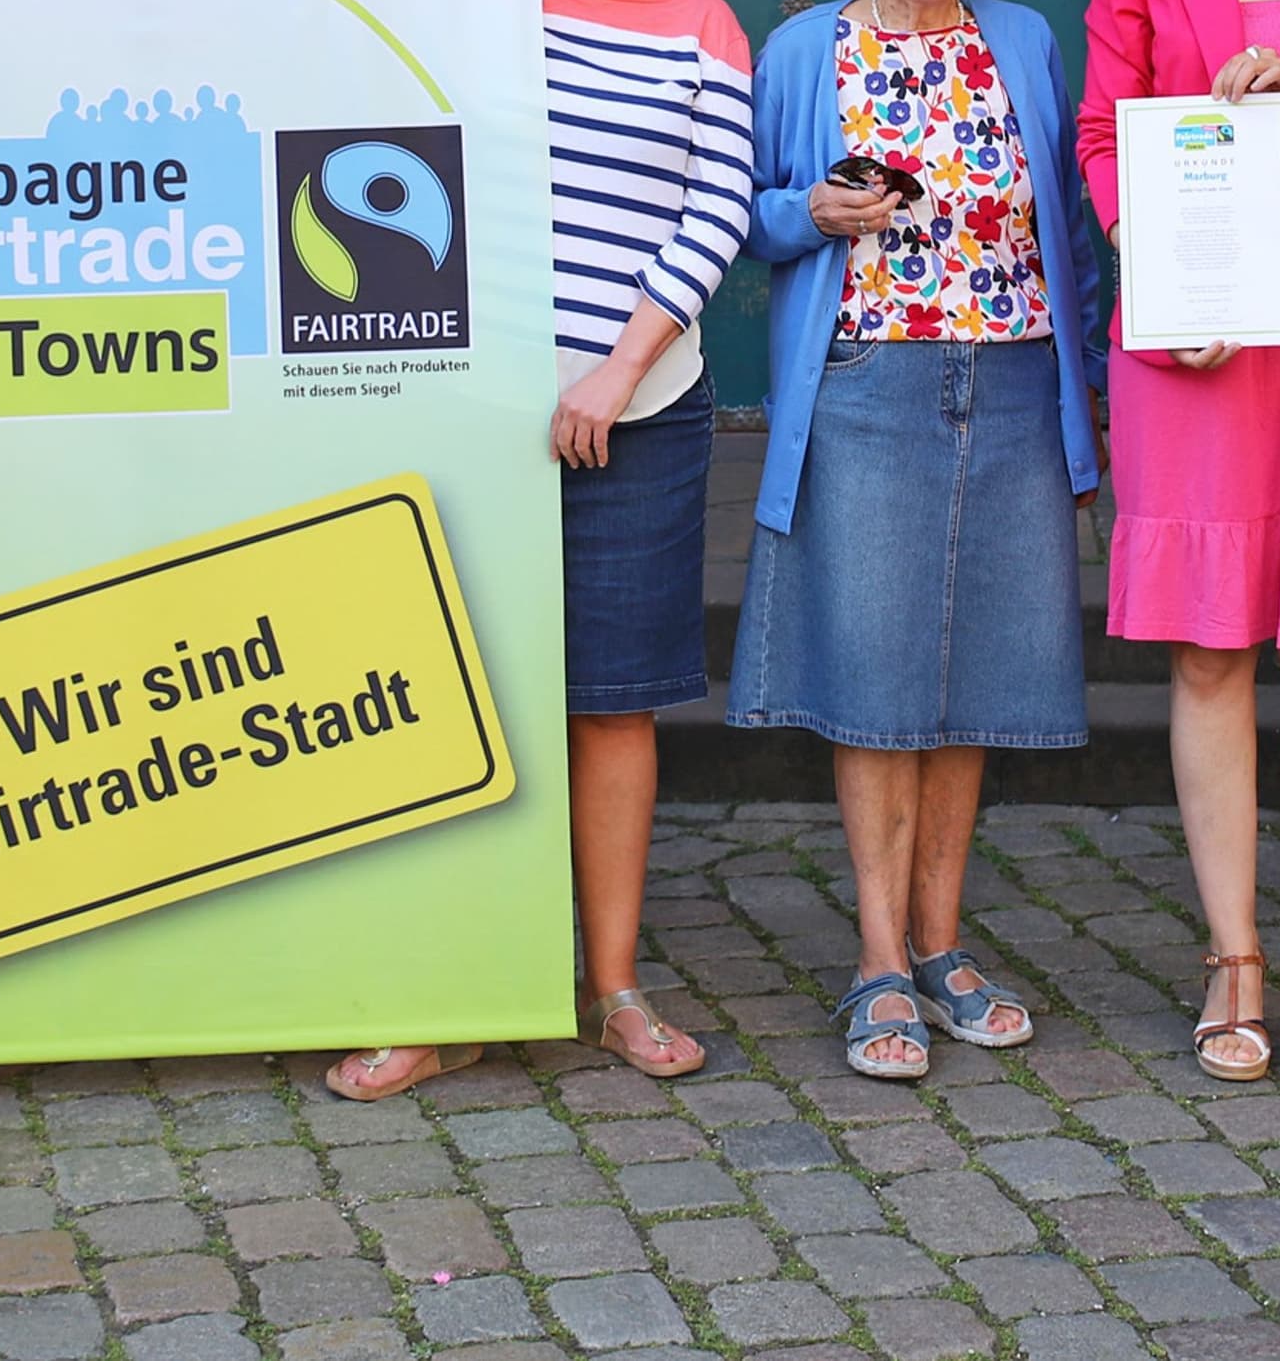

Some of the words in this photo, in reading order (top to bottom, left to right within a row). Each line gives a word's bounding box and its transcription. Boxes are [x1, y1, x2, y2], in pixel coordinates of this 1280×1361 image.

[1184, 171, 1227, 182] Marburg
[293, 310, 458, 342] FAIRTRADE
[282, 364, 338, 377] Schauen
[342, 362, 362, 375] Sie
[366, 360, 397, 374] nach
[401, 358, 470, 373] Produkten
[283, 386, 305, 398] mit
[309, 384, 357, 397] diesem
[360, 382, 402, 398] Siegel
[142, 615, 286, 713] sind
